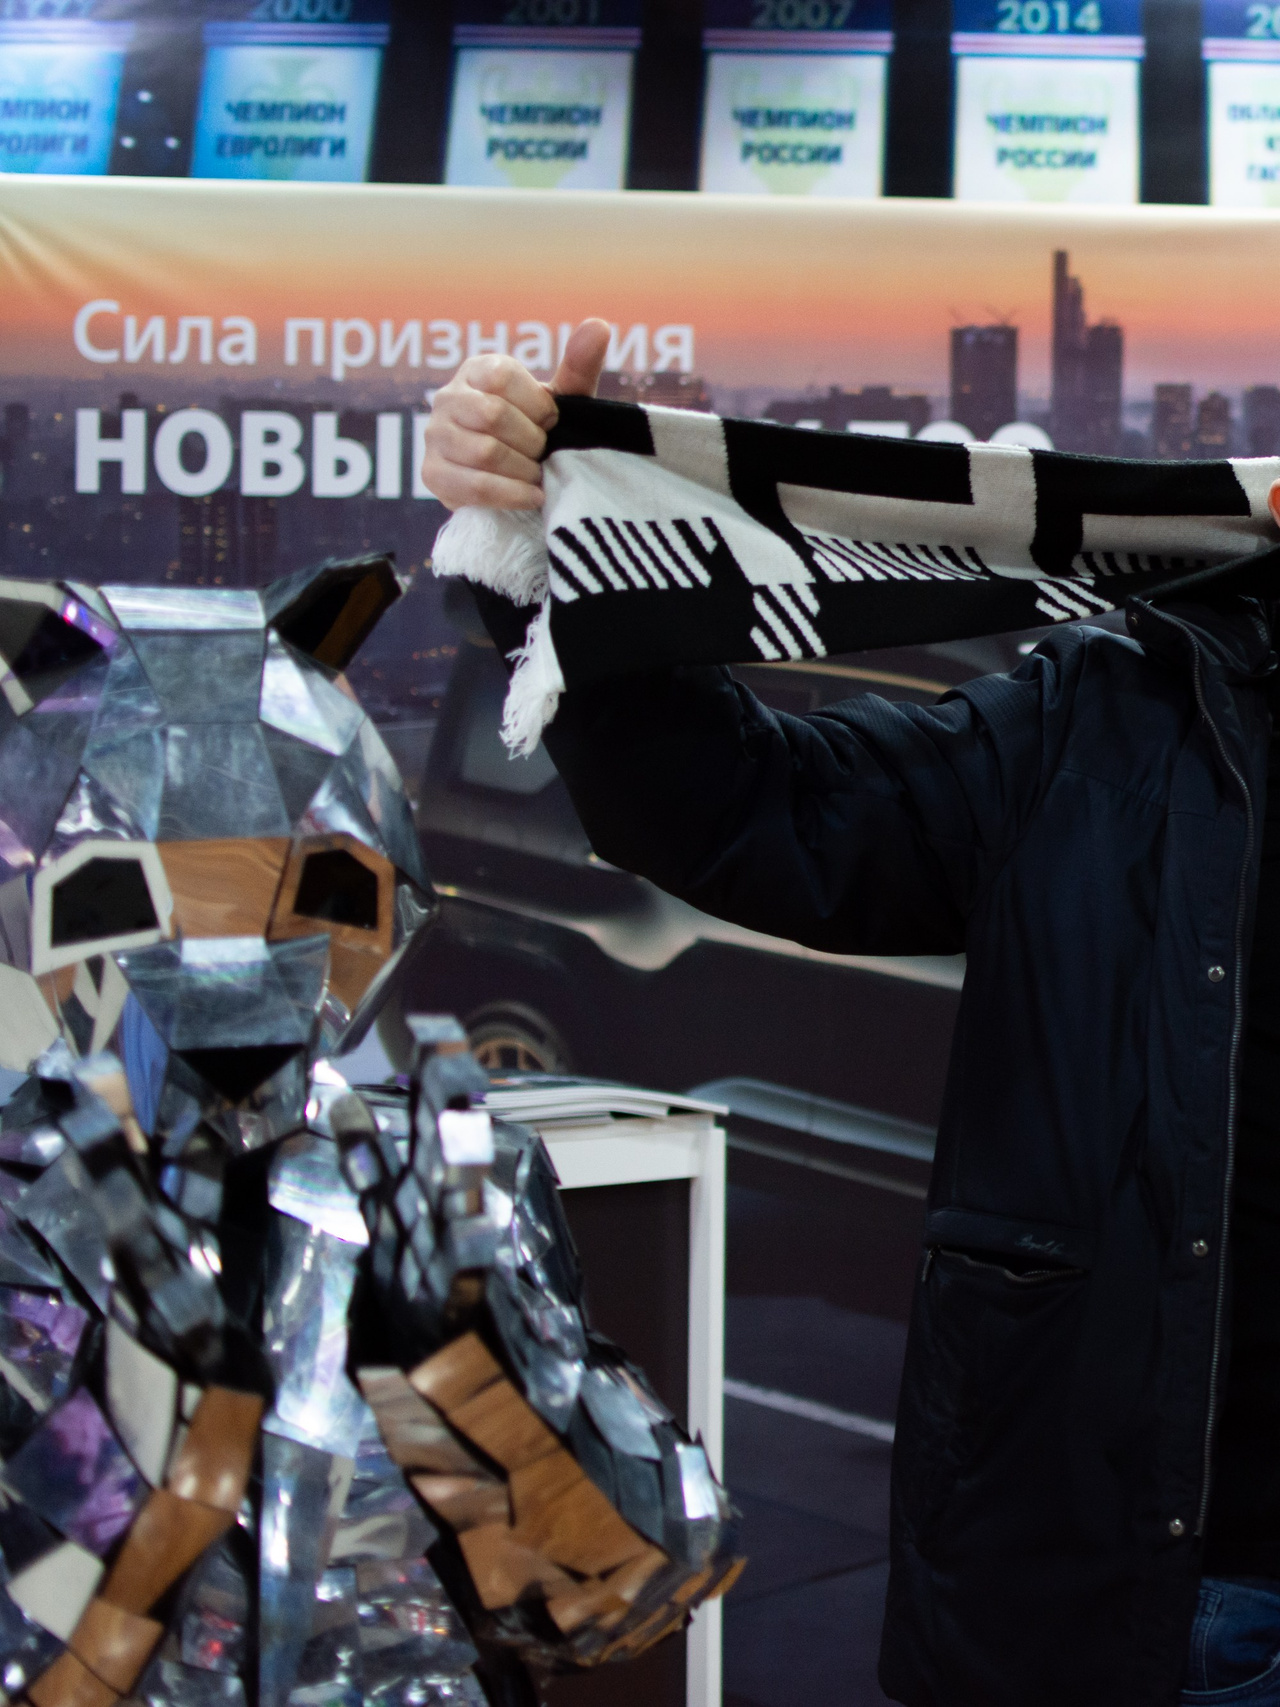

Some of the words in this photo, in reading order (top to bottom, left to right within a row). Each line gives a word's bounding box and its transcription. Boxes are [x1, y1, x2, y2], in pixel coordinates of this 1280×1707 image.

[754, 0, 853, 28] 2007
[998, 0, 1101, 33] 2014
[225, 102, 347, 122] ЧЕМПИОН
[479, 104, 602, 125] ЧЕМПИОН
[731, 108, 856, 130] ЧЕМПИОН
[986, 114, 1108, 135] ЧЕМПИОН
[216, 135, 347, 158] ЕВРОЛИГИ
[486, 138, 589, 160] РОССИИ
[741, 142, 843, 164] РОССИИ
[996, 148, 1098, 169] РОССИИ
[74, 299, 259, 366] Сила
[75, 388, 438, 500] НОВЫ
